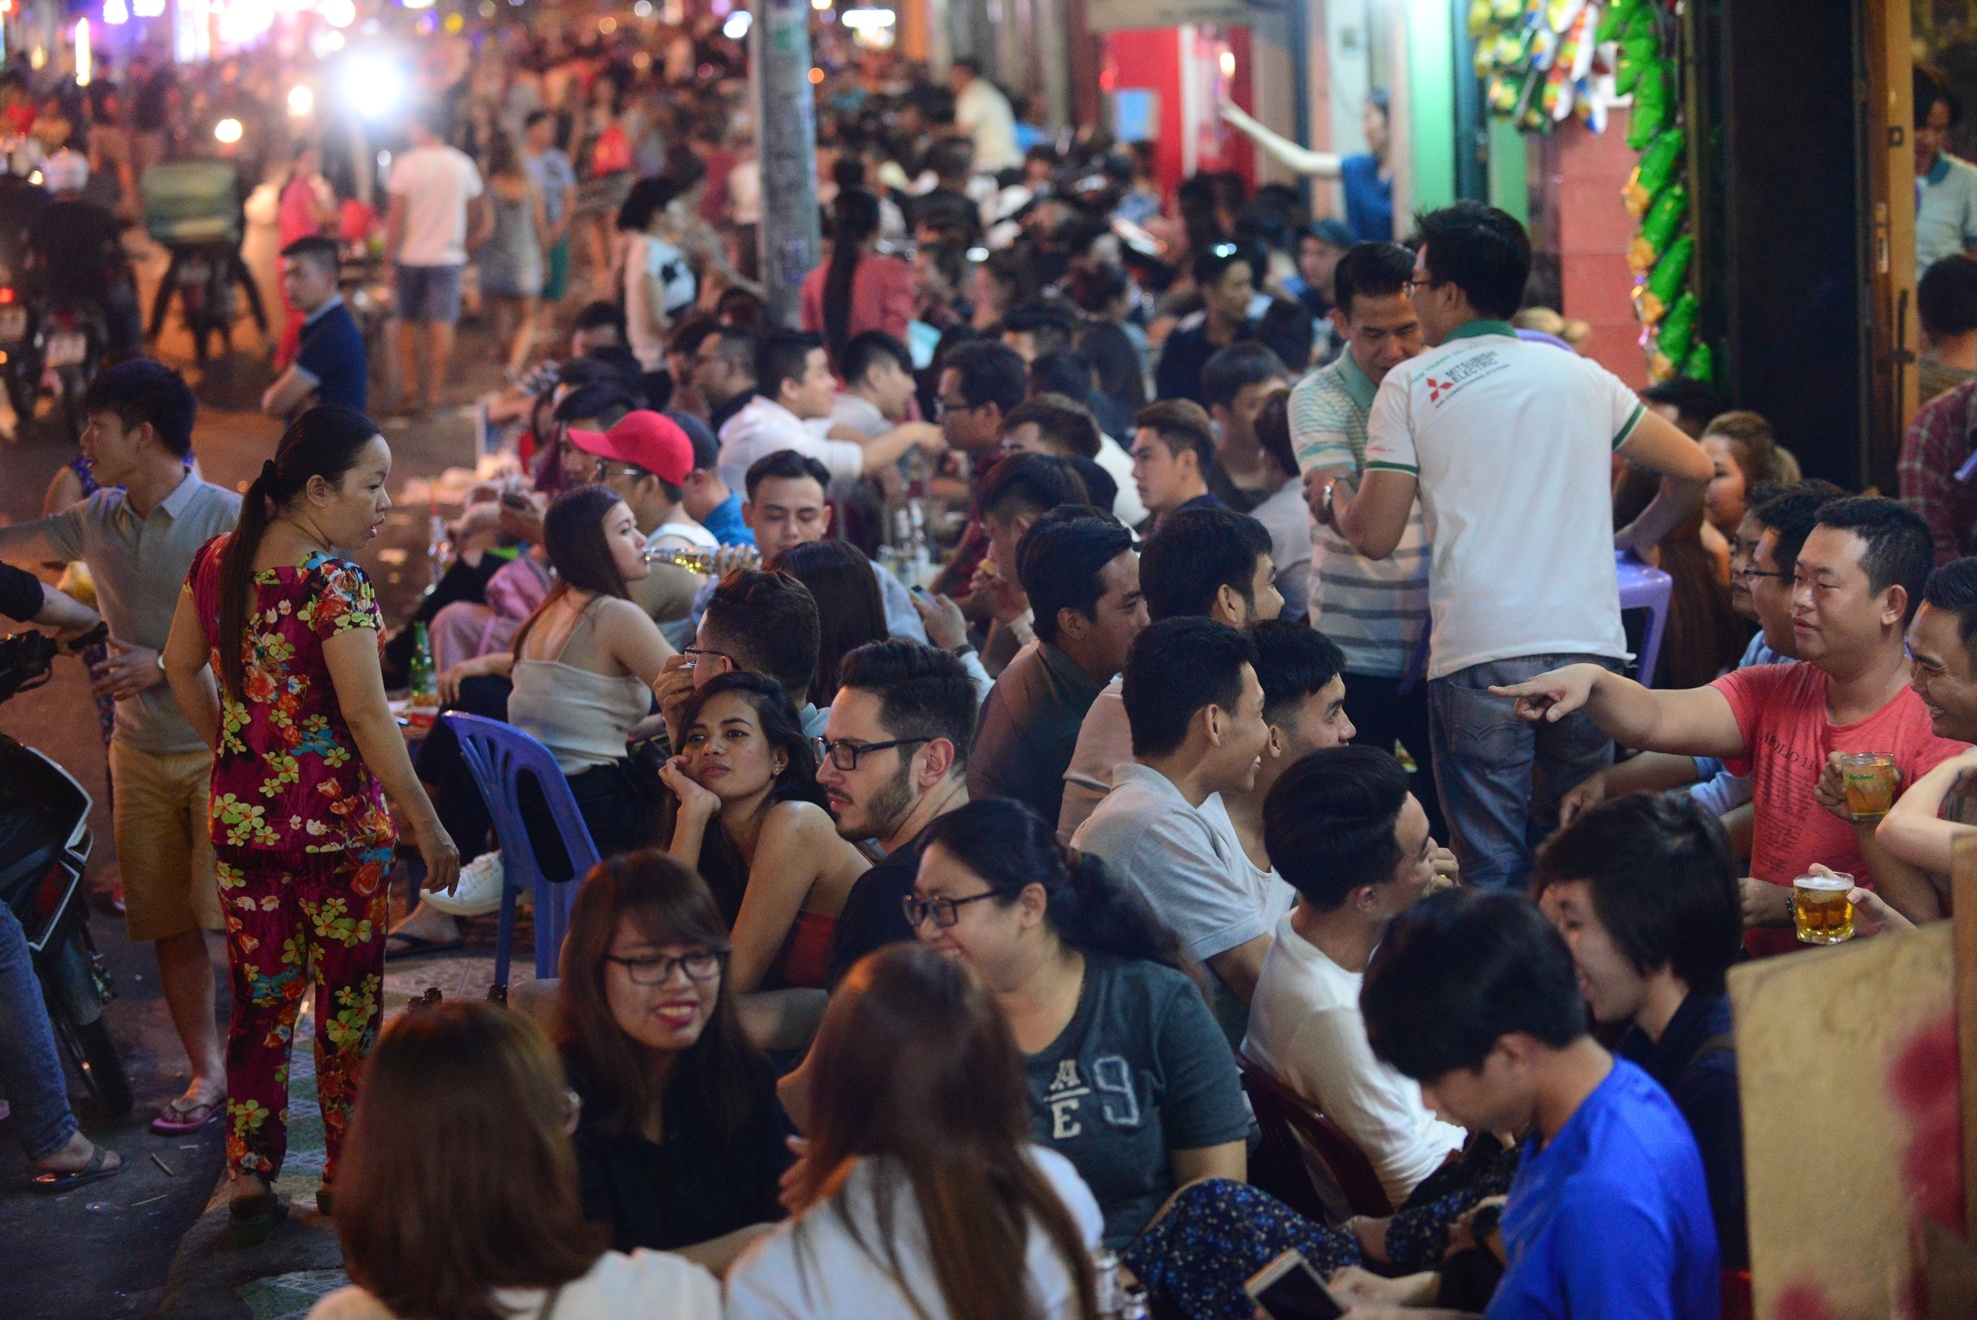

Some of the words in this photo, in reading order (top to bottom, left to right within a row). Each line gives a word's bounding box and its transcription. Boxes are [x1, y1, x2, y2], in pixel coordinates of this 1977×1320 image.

[1445, 350, 1498, 377] MITSUBISHI
[1452, 358, 1498, 383] ELECTRIC
[1763, 731, 1800, 763] APOLLO
[1801, 757, 1815, 770] 11
[1049, 1059, 1081, 1091] A
[1093, 1055, 1140, 1126] 9
[1051, 1098, 1081, 1139] E
